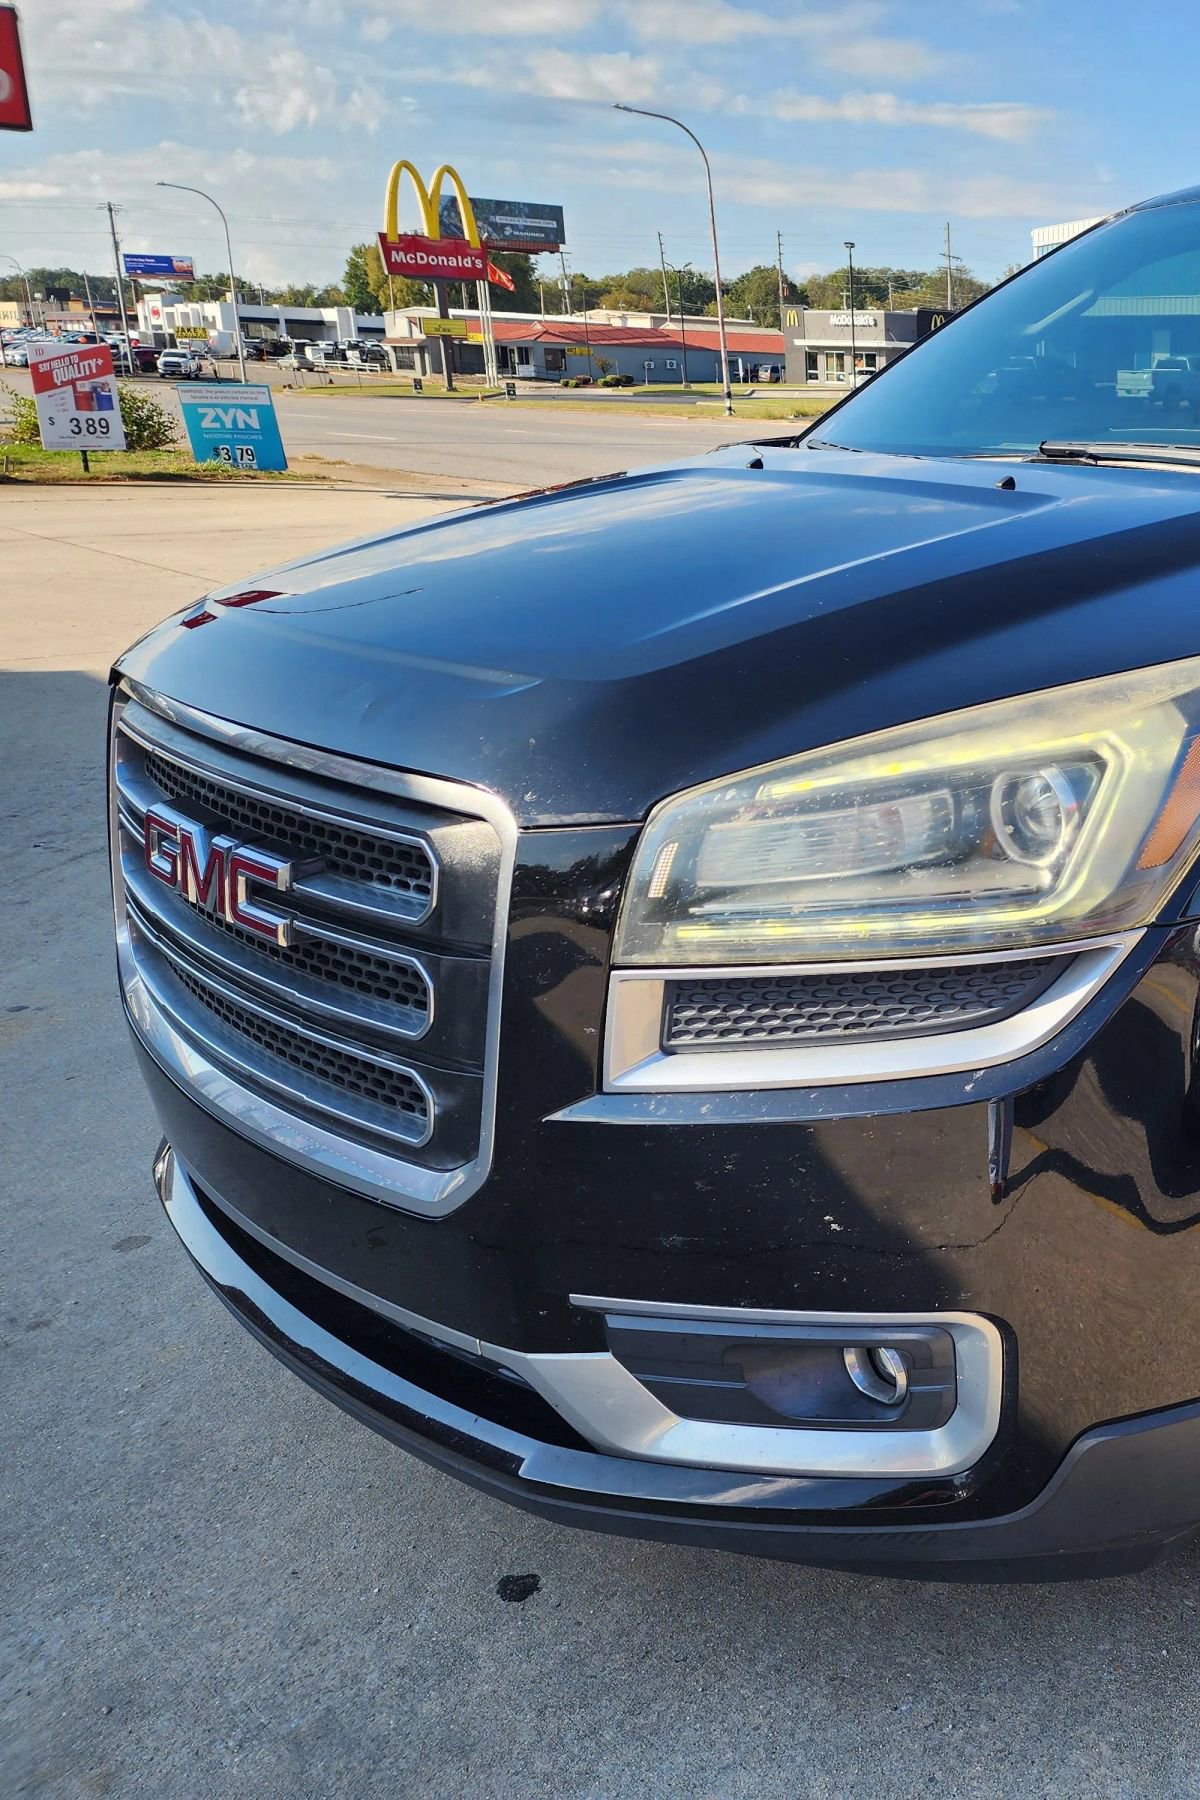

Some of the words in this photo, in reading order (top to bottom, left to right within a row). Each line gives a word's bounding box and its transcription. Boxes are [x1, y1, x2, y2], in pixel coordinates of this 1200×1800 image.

[391, 250, 483, 269] McDonald's
[38, 363, 51, 373] SAY
[50, 356, 70, 370] HELLO
[69, 354, 79, 364] TO
[197, 407, 261, 429] ZYN
[144, 803, 292, 947] GMC
